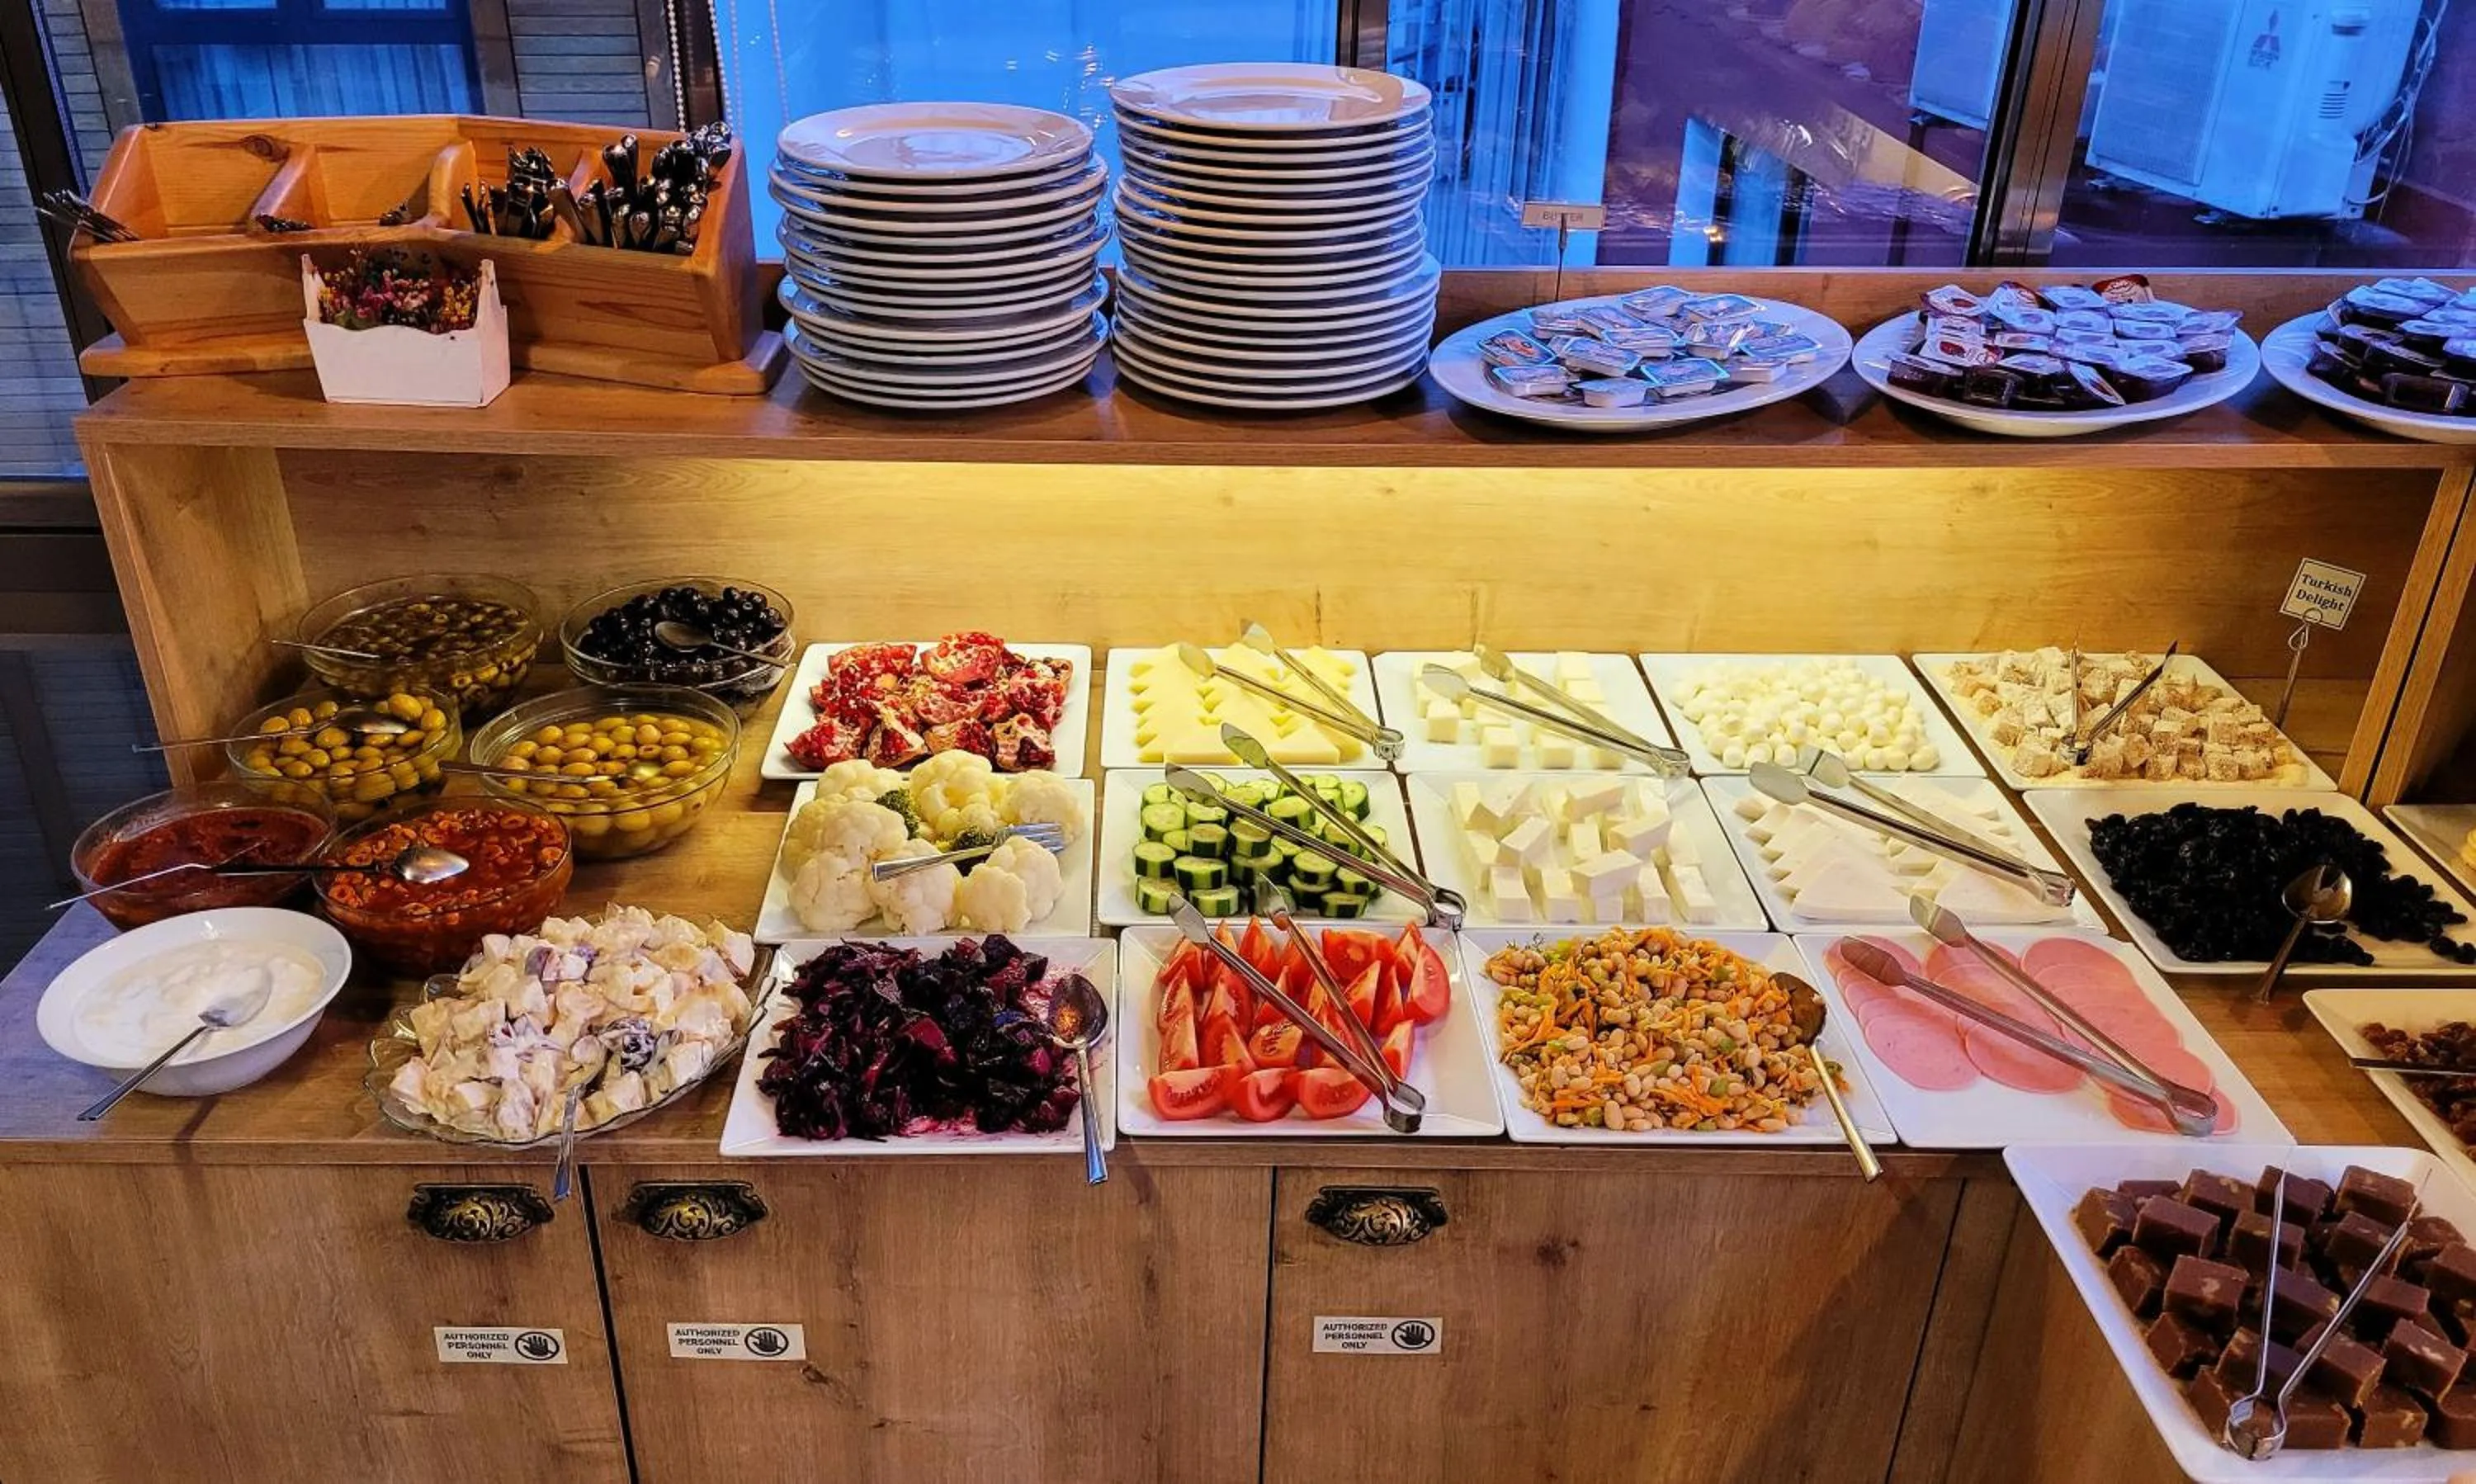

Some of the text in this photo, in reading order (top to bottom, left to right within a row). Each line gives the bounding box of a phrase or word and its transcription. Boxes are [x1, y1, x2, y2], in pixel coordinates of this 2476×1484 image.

[2302, 574, 2352, 597] Turkish
[2296, 588, 2345, 612] Delight
[1323, 1323, 1387, 1331] AUTHORIZED
[443, 1332, 509, 1341] AUTHORIZED
[674, 1328, 740, 1337] AUTHORIZED
[447, 1341, 508, 1350] PERSONNEL
[678, 1338, 739, 1346] PERSONNEL
[466, 1351, 492, 1359] ONLY
